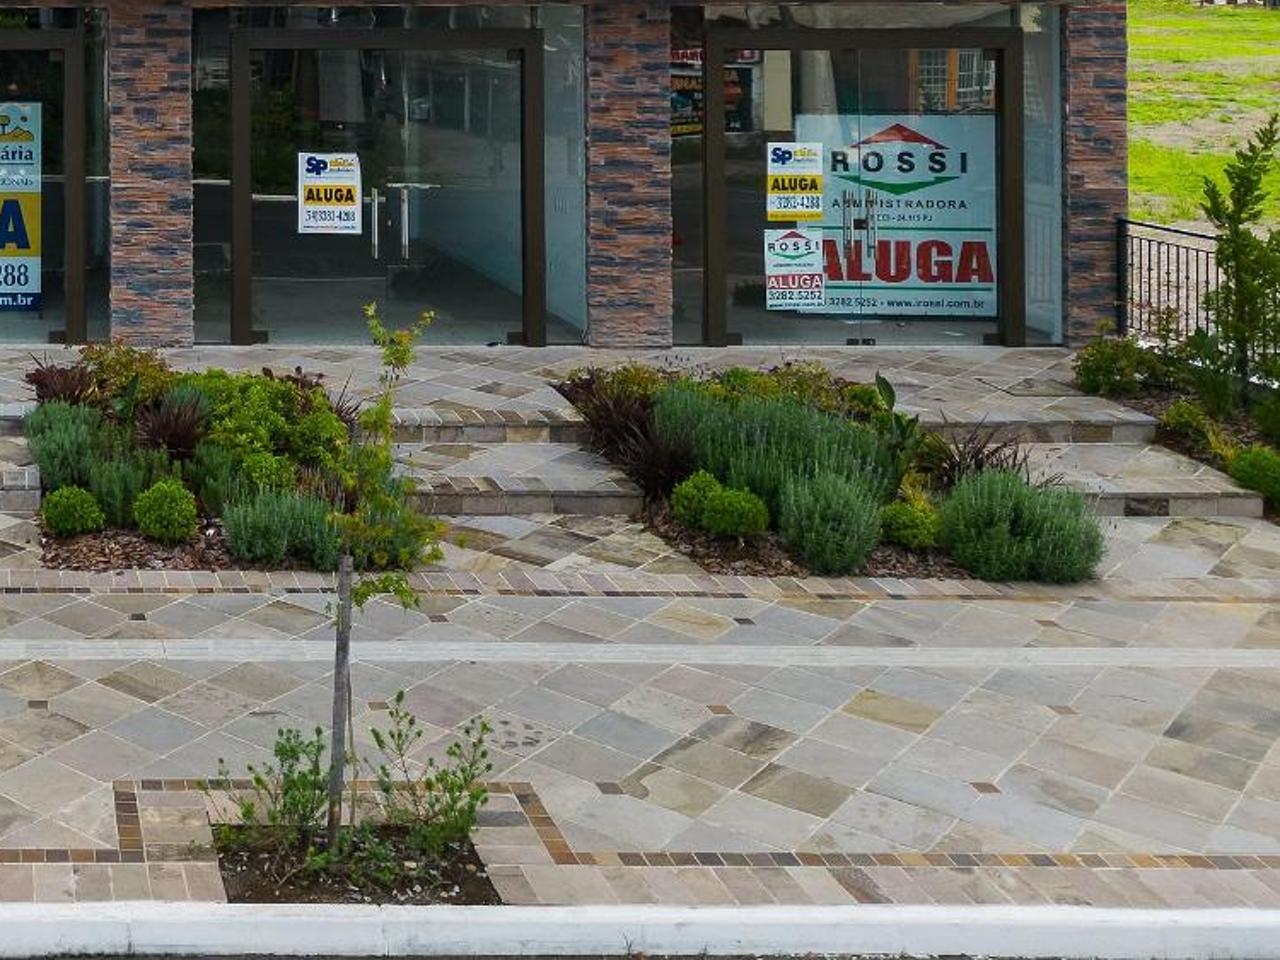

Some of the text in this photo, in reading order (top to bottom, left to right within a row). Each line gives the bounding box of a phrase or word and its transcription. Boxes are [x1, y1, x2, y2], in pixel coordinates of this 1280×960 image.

[831, 151, 969, 173] ROSSI
[771, 177, 818, 191] ALUGA
[305, 187, 356, 202] ALUGA
[768, 241, 820, 252] ROSSI
[823, 239, 994, 283] ALUGA
[767, 275, 822, 289] ALUGA
